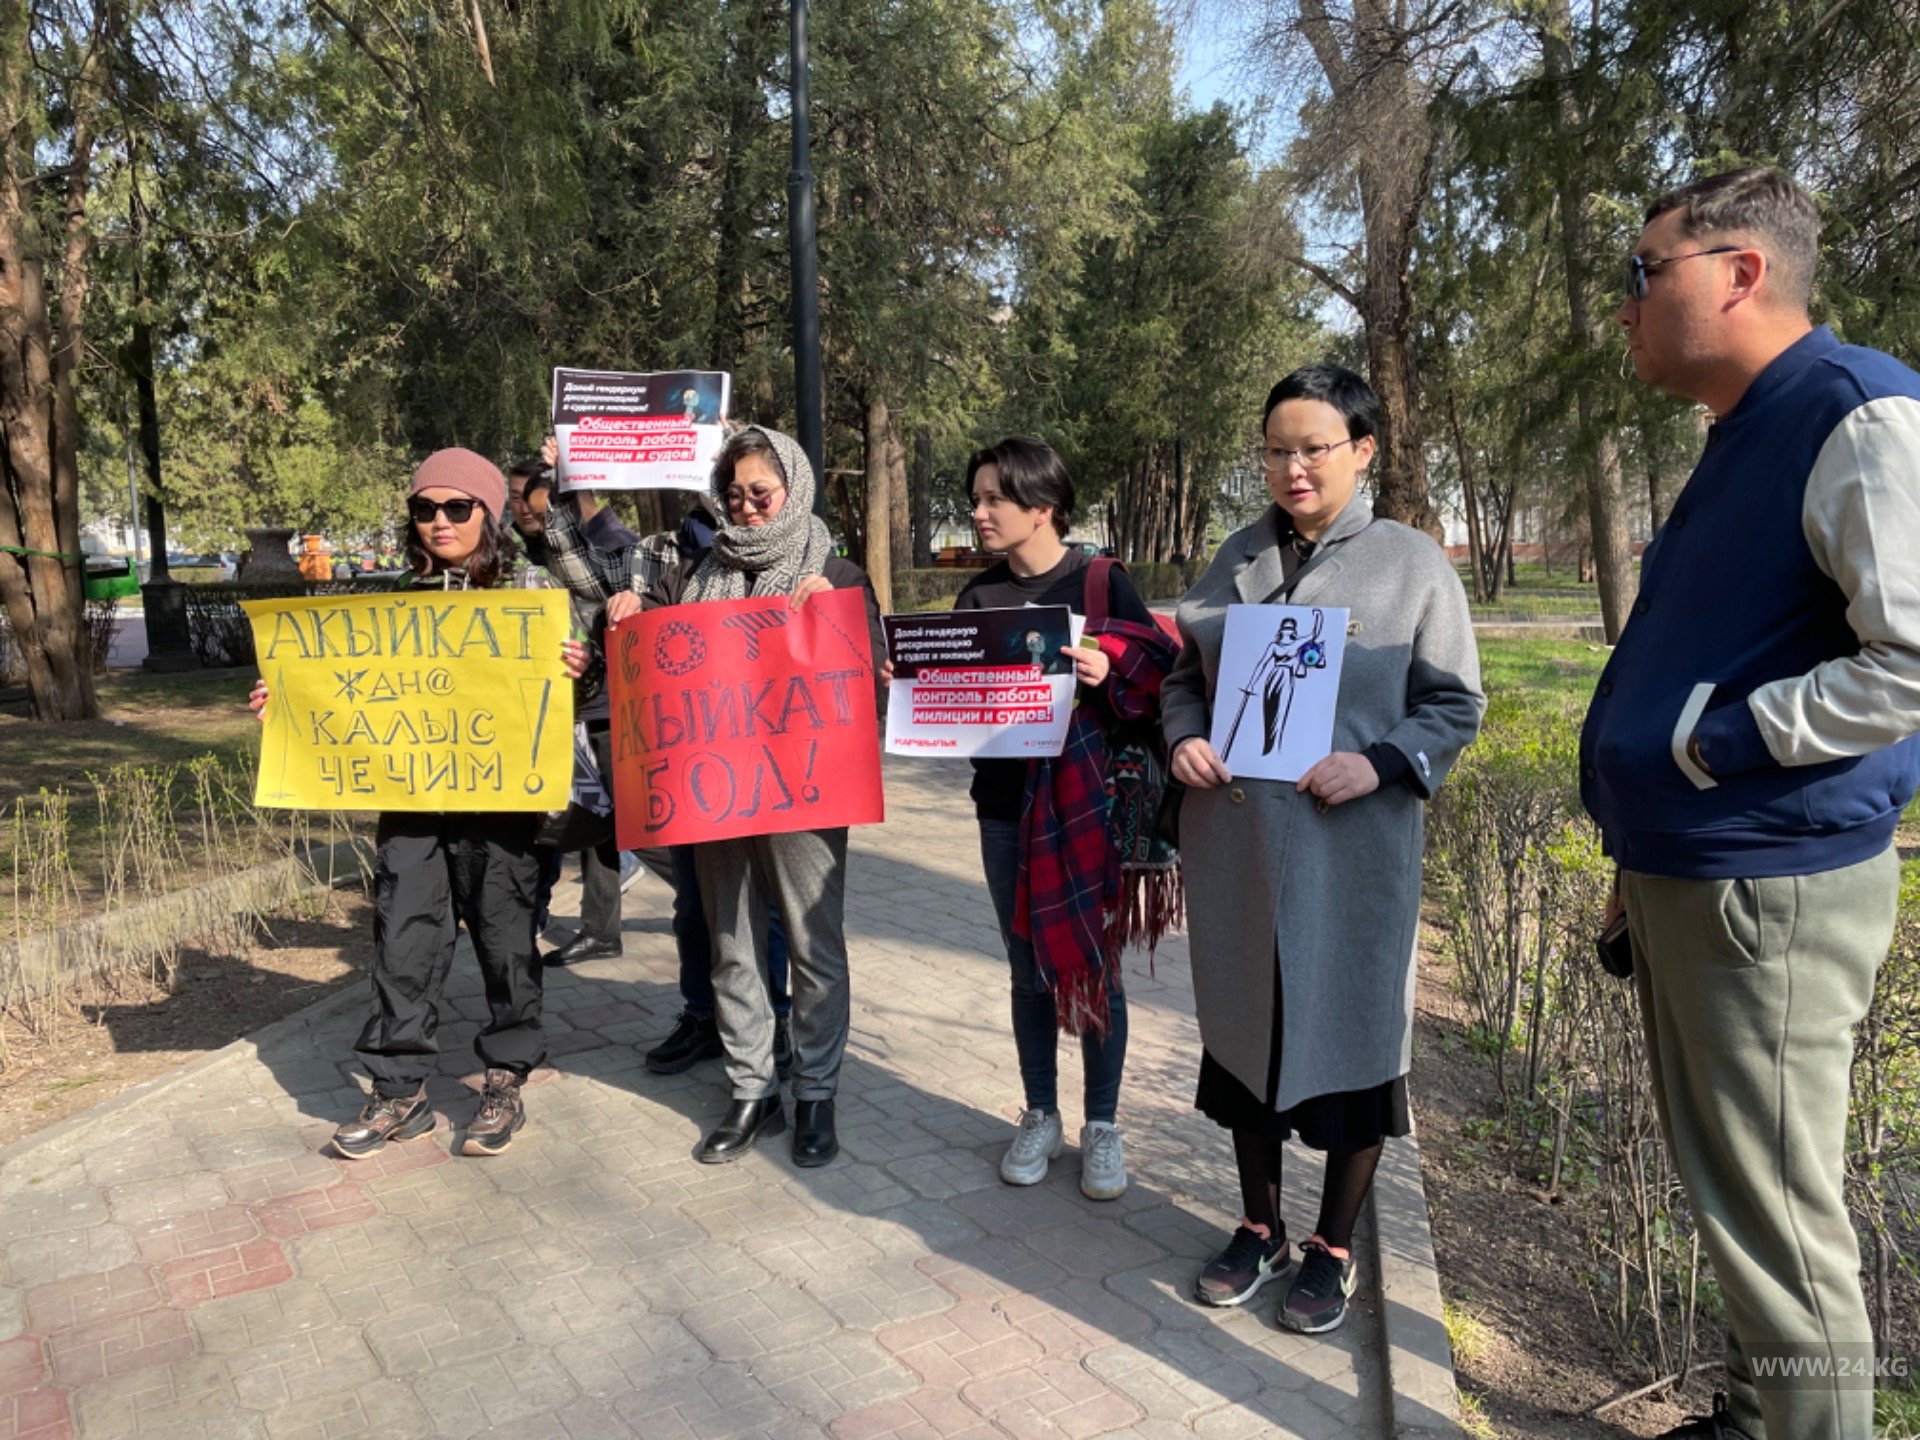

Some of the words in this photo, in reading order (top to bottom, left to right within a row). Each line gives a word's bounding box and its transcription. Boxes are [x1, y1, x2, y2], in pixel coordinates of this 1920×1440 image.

[563, 382, 594, 392] Долой
[596, 385, 647, 394] гендерную
[563, 394, 640, 403] дискриминацию
[571, 404, 597, 412] судах
[579, 415, 692, 431] Общественный
[570, 435, 639, 447] контроль
[641, 432, 697, 446] работы
[568, 449, 632, 463] милиции
[635, 450, 646, 460] и
[649, 449, 695, 463] судов!
[266, 600, 545, 660] АКЫЙКАТ
[895, 627, 923, 638] Долой
[925, 626, 978, 637] гендерную
[620, 609, 790, 685] СОТ
[895, 639, 972, 650] дискриминацию
[904, 653, 930, 663] судах
[918, 666, 1041, 684] Общественный
[913, 690, 982, 704] контроль
[985, 688, 1051, 703] работы
[617, 668, 864, 761] АКЫЙКАТ
[913, 709, 980, 723] милиции
[983, 711, 993, 721] и
[996, 706, 1052, 725] судов!
[310, 708, 496, 746] КАЛЫС
[318, 751, 503, 796] ЧЕЧИМ
[640, 739, 821, 832] БОЛ!
